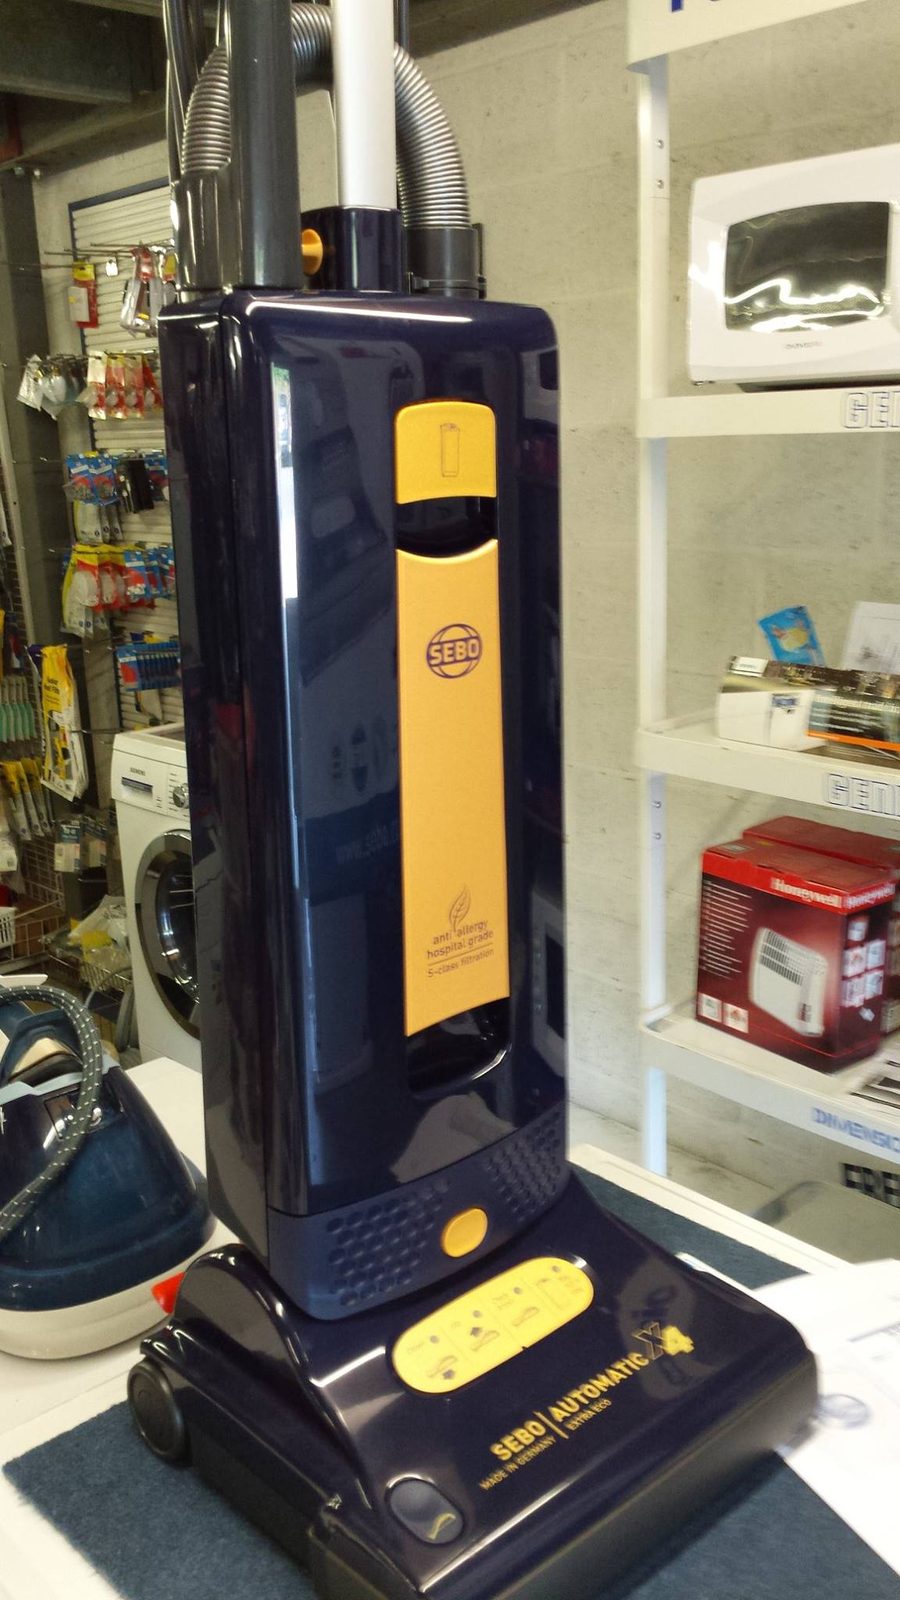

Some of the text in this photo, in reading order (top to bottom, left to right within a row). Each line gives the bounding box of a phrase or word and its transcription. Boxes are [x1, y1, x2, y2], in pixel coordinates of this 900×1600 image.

[429, 638, 480, 665] SEBO
[824, 773, 900, 818] GEN
[770, 878, 842, 908] Honeywell
[427, 930, 494, 959] hospital grade
[432, 920, 488, 945] anti allergy
[489, 1321, 695, 1461] SEBO AUTOMATIC X4
[563, 1398, 613, 1431] EXTRA ECO
[479, 1434, 557, 1491] MADE IN GERMANY
